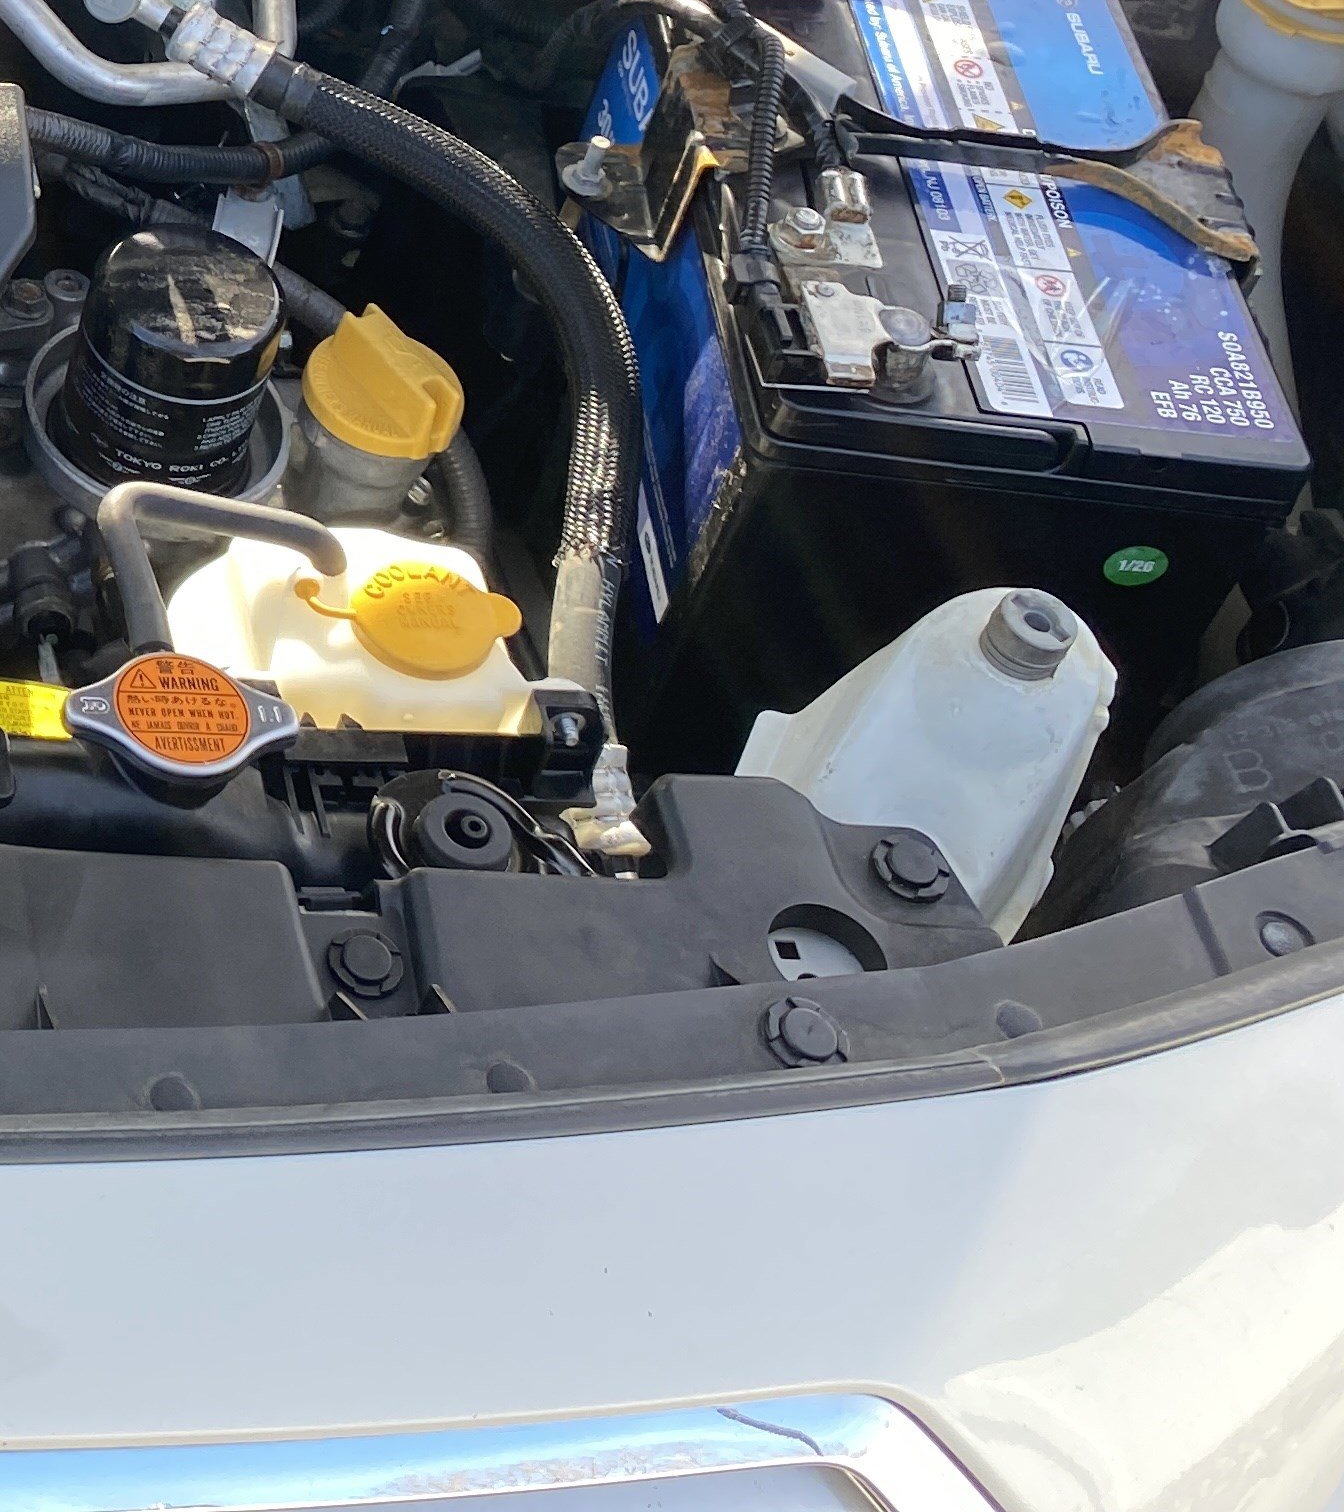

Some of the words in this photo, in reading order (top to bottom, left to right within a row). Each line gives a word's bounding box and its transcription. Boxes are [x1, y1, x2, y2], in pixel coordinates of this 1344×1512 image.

[1065, 13, 1104, 75] SUBARU
[1168, 379, 1192, 400] Ah
[1189, 374, 1214, 395] RC
[1209, 367, 1237, 396] CCA
[1217, 330, 1274, 429] SOA821B950
[1150, 390, 1178, 419] EFB
[1178, 403, 1202, 422] 76
[1199, 398, 1226, 425] 120
[1222, 400, 1250, 427] 750
[115, 448, 163, 470] TOKYO
[169, 463, 204, 473] ROKI
[156, 660, 195, 675] 警告
[158, 676, 219, 692] WARNING
[128, 707, 156, 716] NEVER
[161, 708, 185, 717] OPEN
[188, 709, 214, 718] WHEN
[146, 720, 171, 730] JAMAIS
[155, 735, 226, 753] AVERTISSMENT
